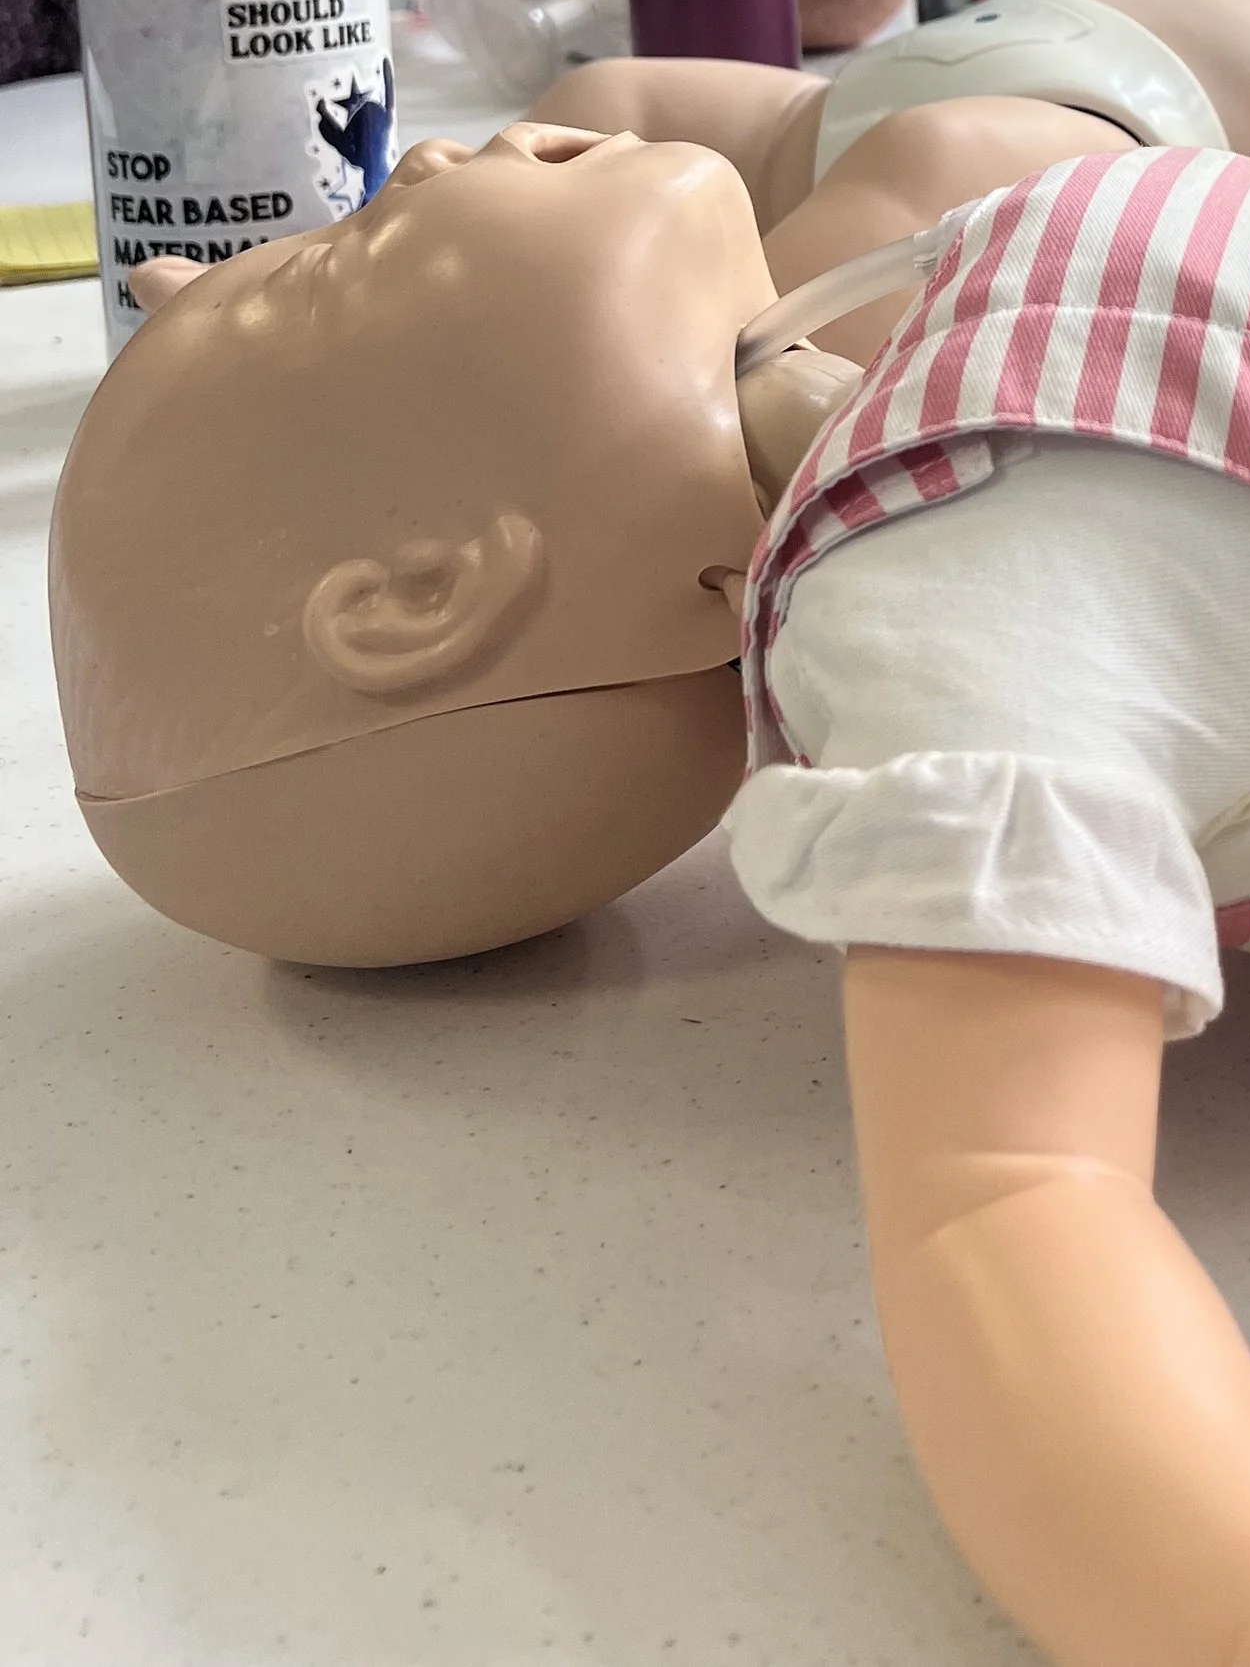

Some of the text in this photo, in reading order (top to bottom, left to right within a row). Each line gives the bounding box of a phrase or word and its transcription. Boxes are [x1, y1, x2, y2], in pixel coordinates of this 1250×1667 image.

[230, 21, 372, 58] LOOK LIKE
[107, 151, 172, 181] STOP
[110, 191, 294, 226] FEAR BASED
